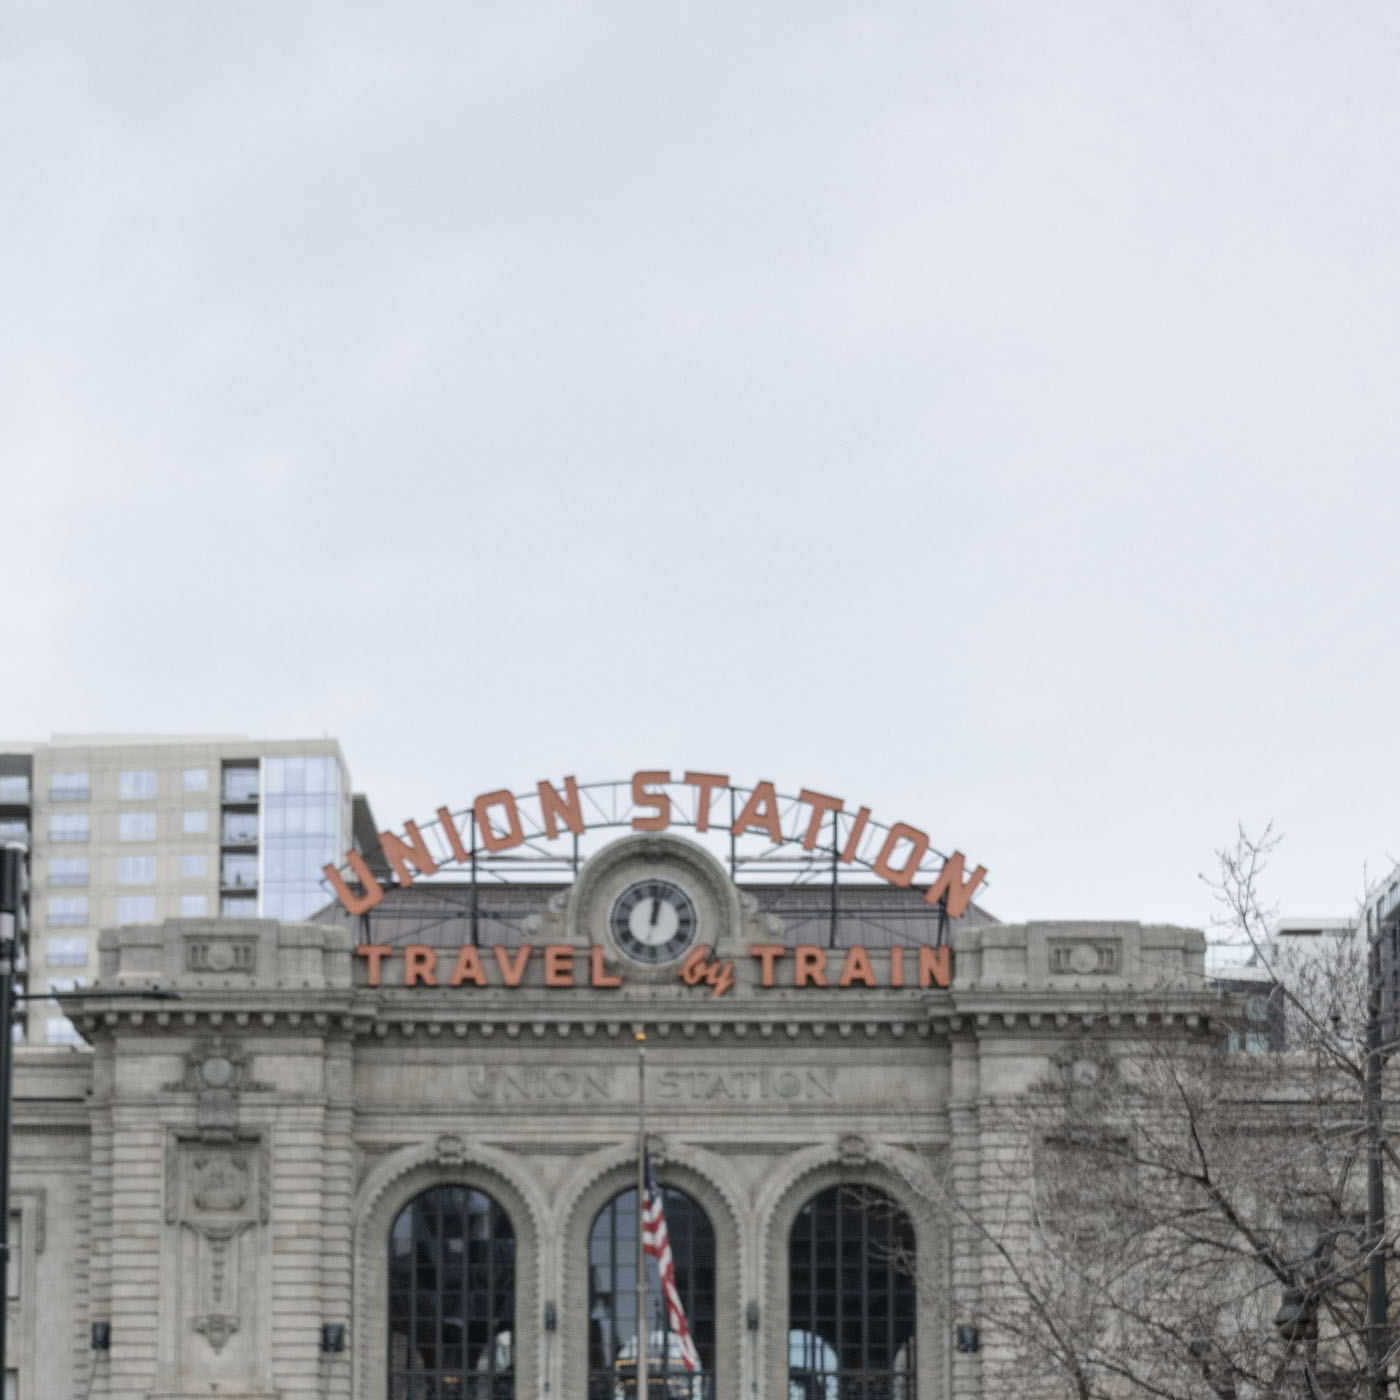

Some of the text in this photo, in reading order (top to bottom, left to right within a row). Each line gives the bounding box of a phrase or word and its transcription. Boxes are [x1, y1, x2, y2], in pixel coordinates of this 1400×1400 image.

[322, 770, 989, 920] UNION STATION
[356, 944, 951, 998] TRAVEL by TRAIN
[466, 1068, 838, 1100] UNION STATION
